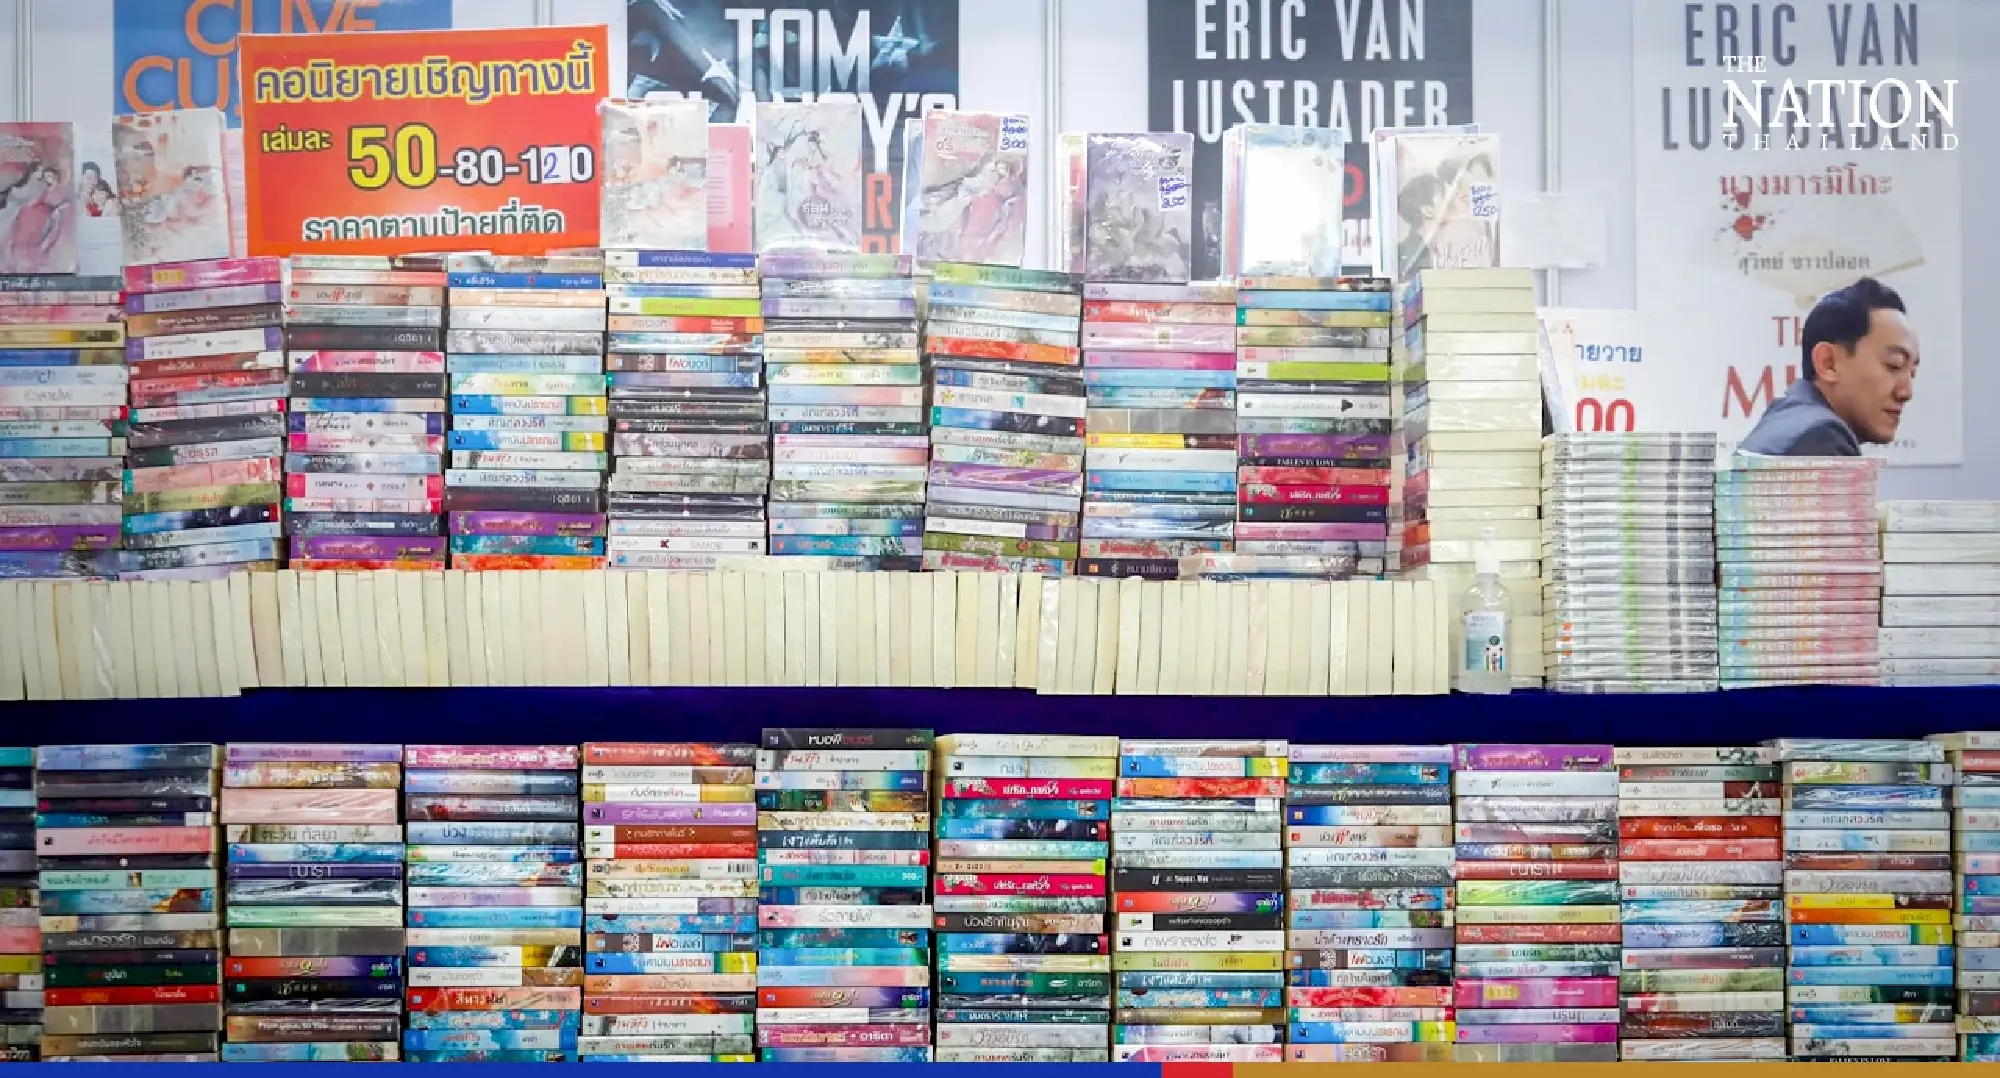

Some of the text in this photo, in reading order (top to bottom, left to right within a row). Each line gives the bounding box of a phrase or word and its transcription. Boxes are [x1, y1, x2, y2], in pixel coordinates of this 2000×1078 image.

[725, 9, 870, 94] TOM
[1196, 0, 1426, 61] ERIC VAN
[1685, 3, 1920, 67] ERIC VAN
[255, 42, 595, 104] คอนิยายเชิญทางนี้
[261, 124, 333, 153] เล่มละ
